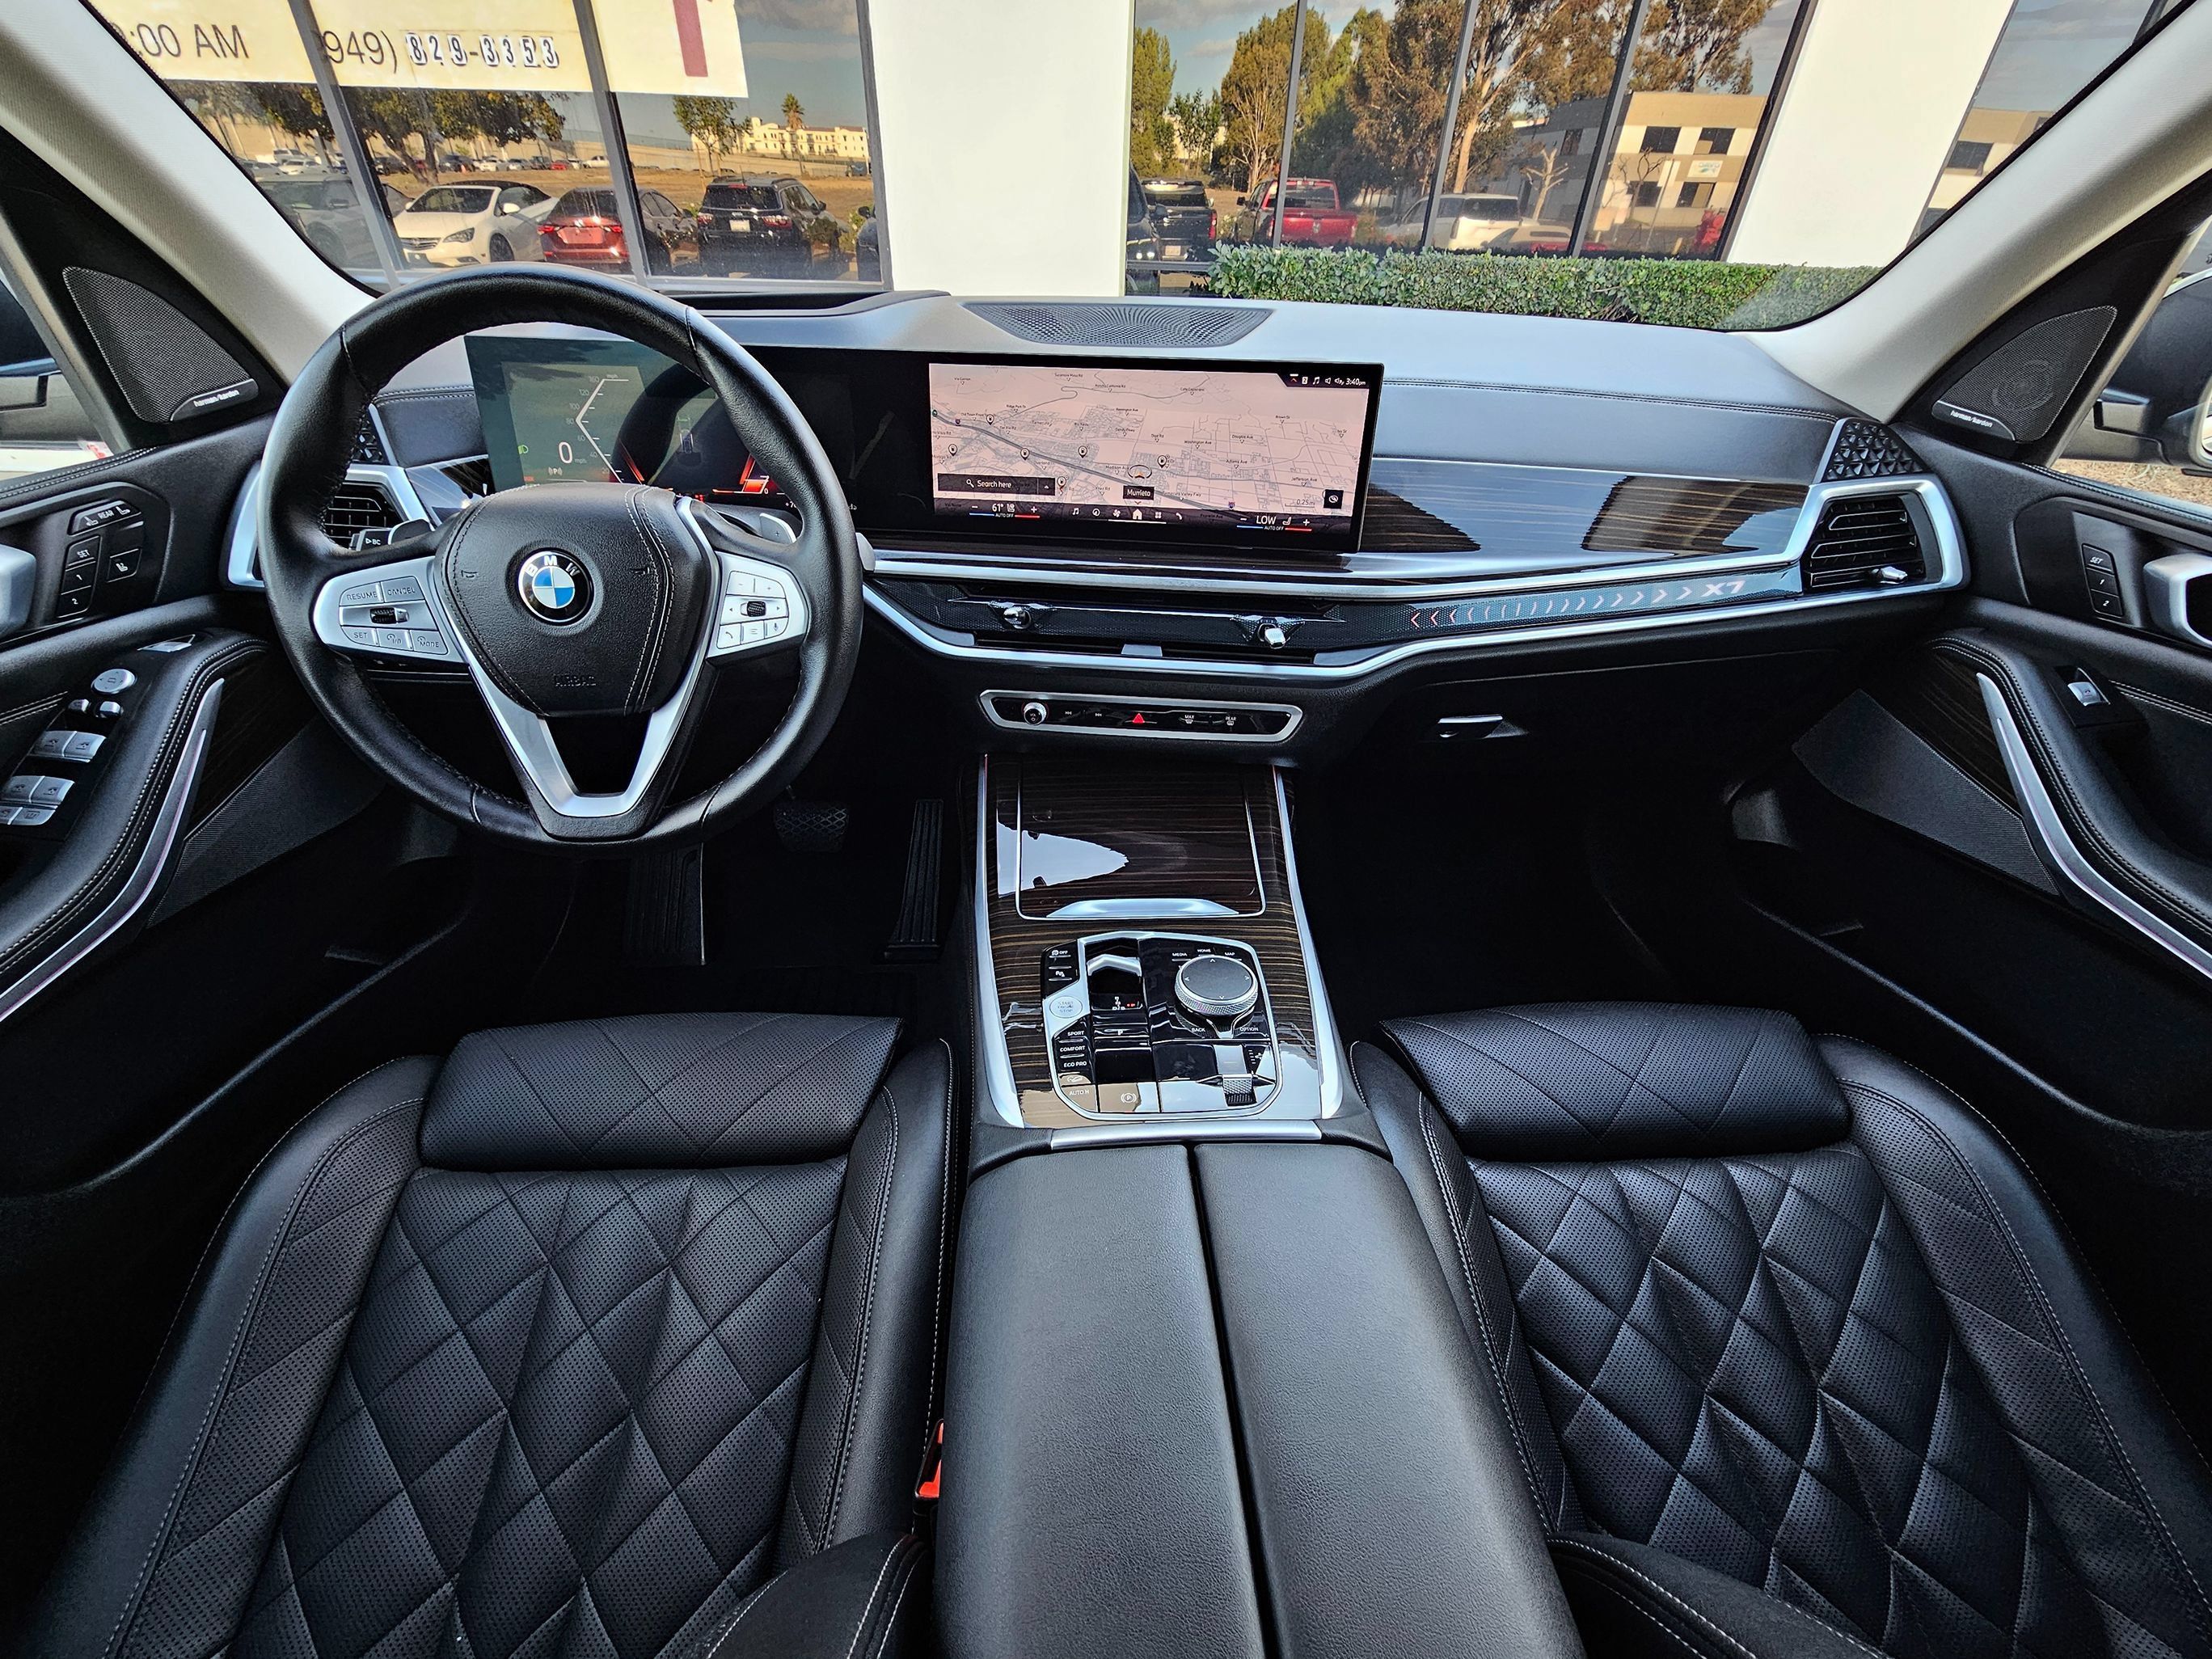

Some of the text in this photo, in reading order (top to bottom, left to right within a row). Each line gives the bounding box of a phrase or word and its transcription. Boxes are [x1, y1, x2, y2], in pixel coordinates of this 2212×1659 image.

[111, 23, 249, 58] :00 AM
[323, 31, 559, 74] 949) 829-3353
[193, 390, 240, 407] harman/kardon
[1950, 410, 1993, 428] harman/kardon
[559, 441, 572, 463] 0
[977, 479, 998, 488] Search
[98, 509, 114, 521] REAR
[1256, 515, 1277, 525] LOW
[77, 549, 91, 559] SET
[2090, 556, 2104, 564] SET
[526, 555, 580, 577] BMW
[346, 586, 416, 601] RESUME CANCEL
[1700, 580, 1746, 597] X7
[354, 631, 369, 640] SET
[1060, 1045, 1086, 1053] COMFORT
